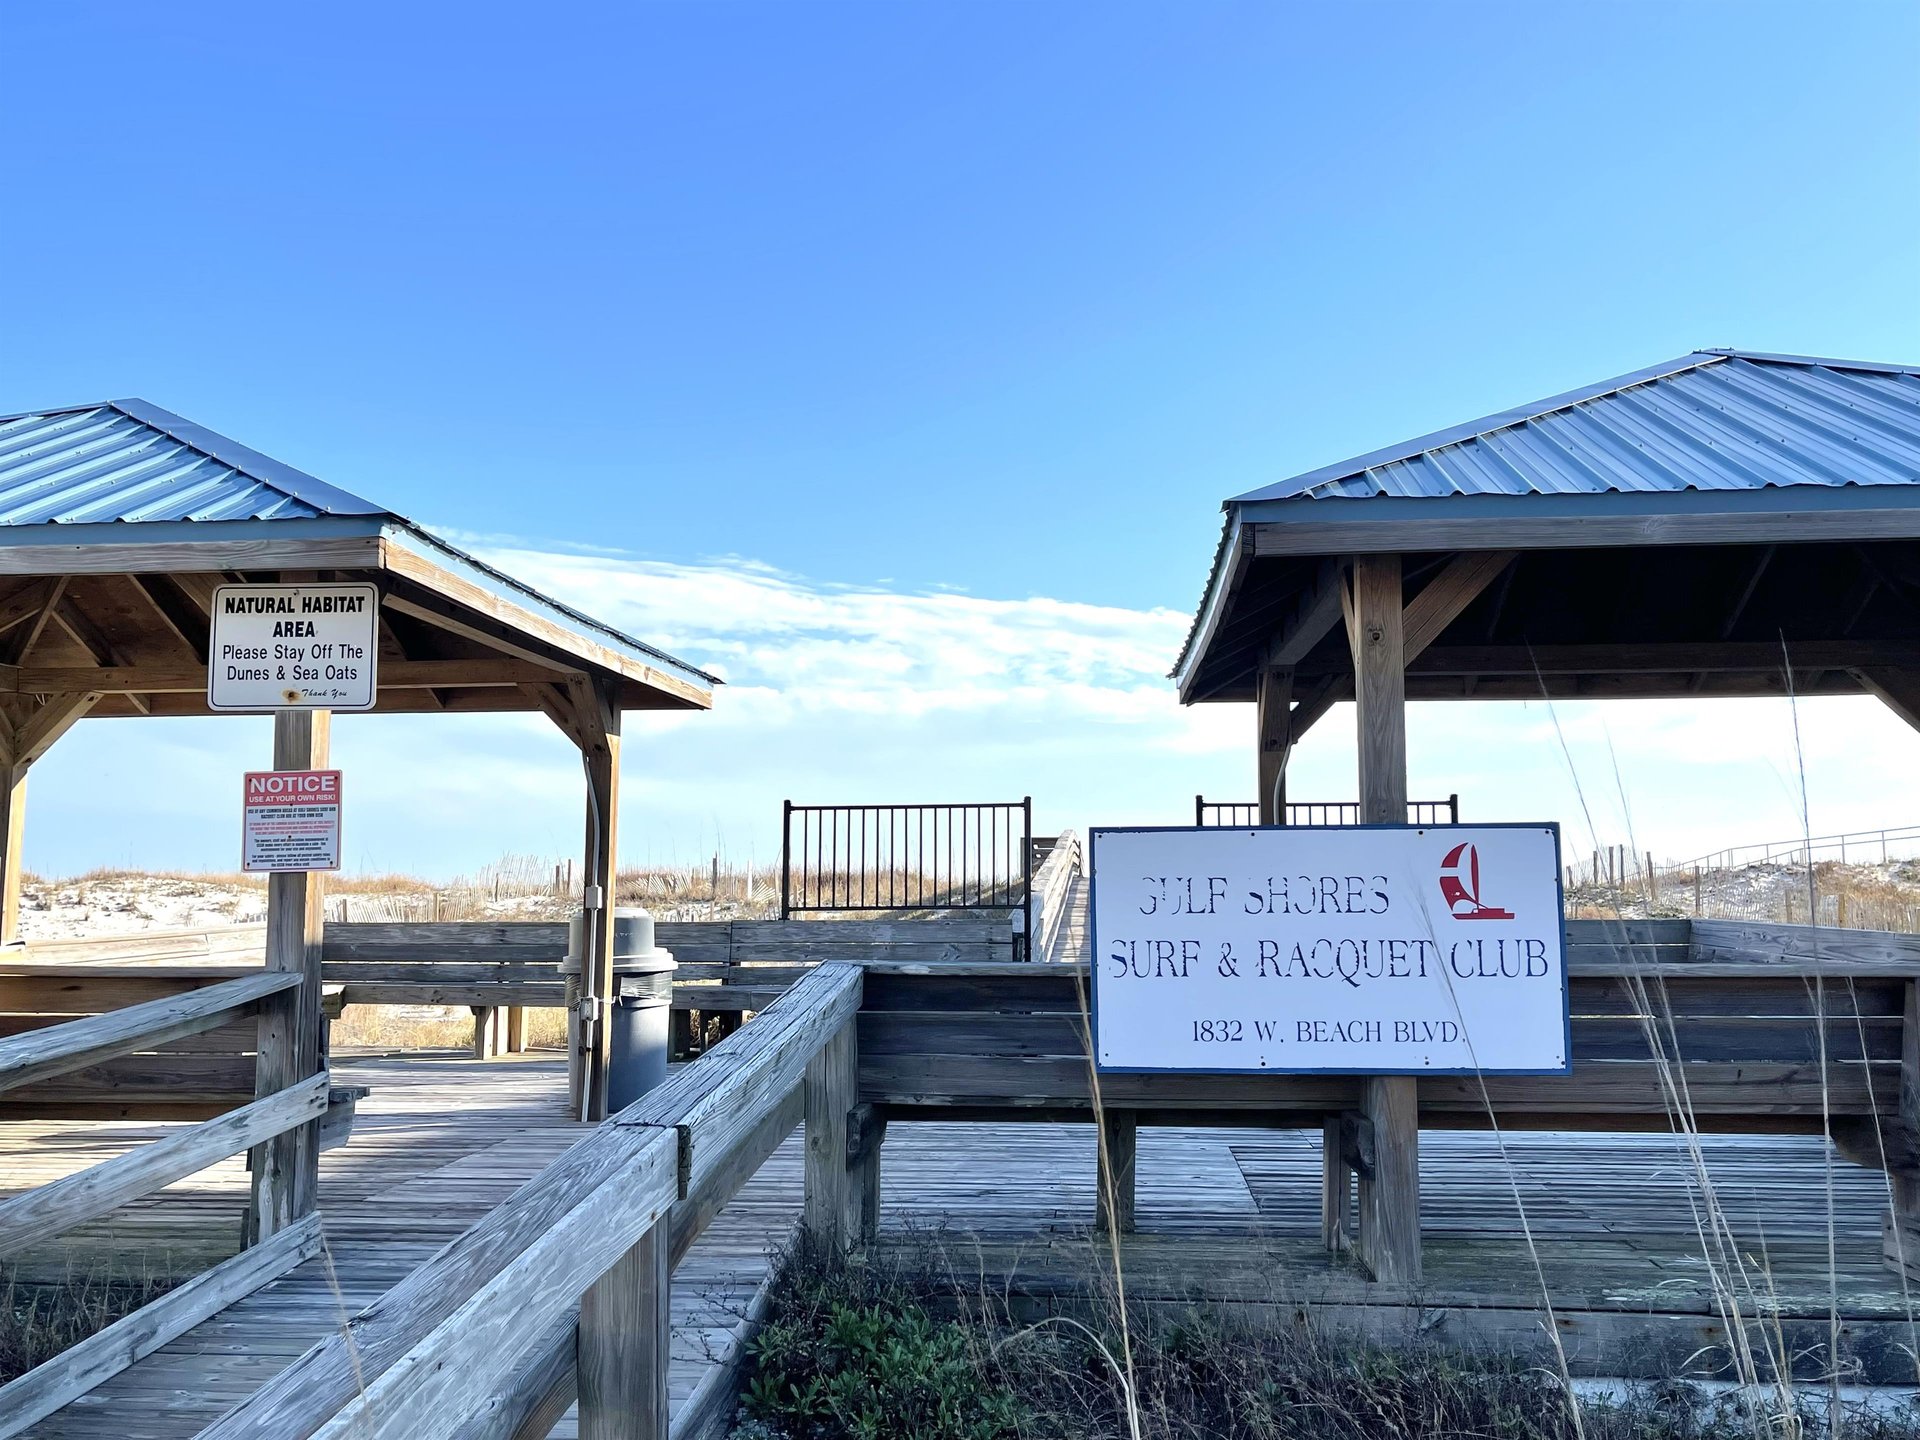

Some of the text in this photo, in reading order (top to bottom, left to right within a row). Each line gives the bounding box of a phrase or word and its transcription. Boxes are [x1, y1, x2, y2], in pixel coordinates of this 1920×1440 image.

[225, 596, 365, 614] NATURAL HABITAT
[273, 621, 315, 638] AREA
[223, 644, 363, 662] Please Stay Off The
[227, 665, 357, 681] Dunes & Sea Oats
[301, 688, 347, 699] Thank You
[250, 776, 335, 793] NOTICE
[1109, 938, 1548, 988] SURF & RACQUET CLUB
[1192, 1020, 1243, 1042] 1832
[1296, 1020, 1382, 1043] BEACH
